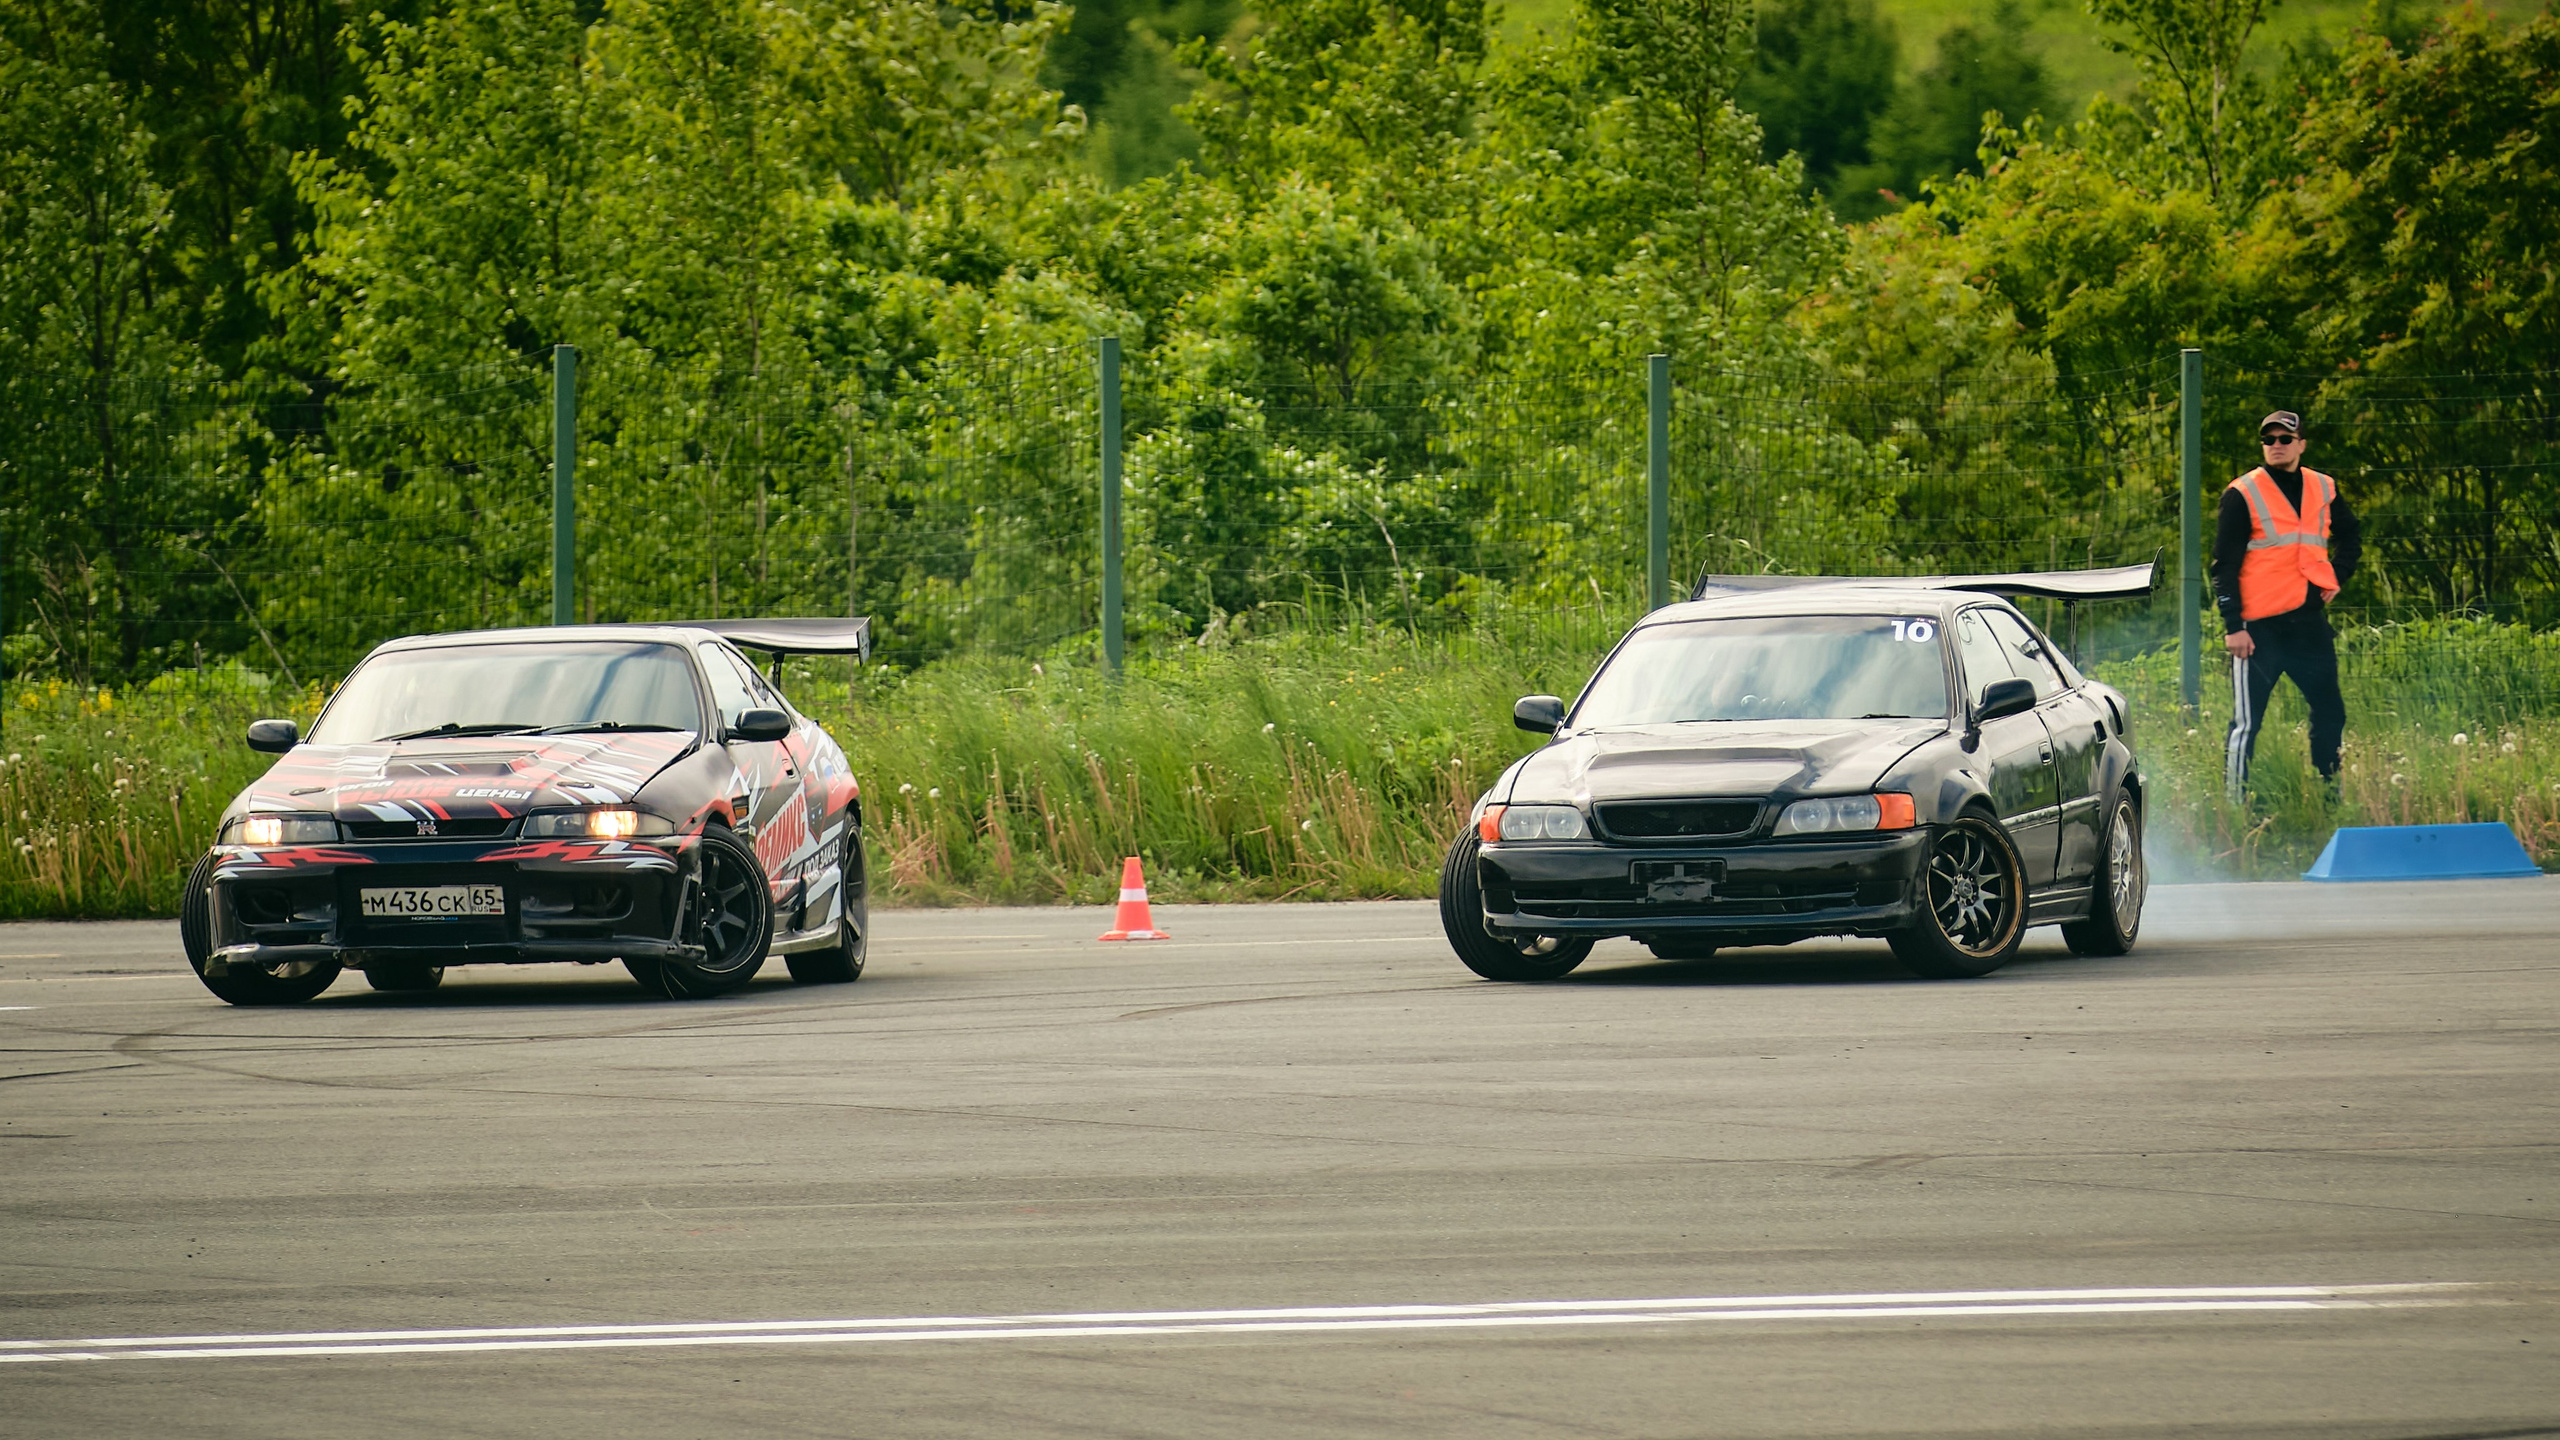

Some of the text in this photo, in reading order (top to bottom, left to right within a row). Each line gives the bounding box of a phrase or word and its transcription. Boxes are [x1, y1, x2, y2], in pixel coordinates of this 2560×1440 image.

[1891, 620, 1933, 643] 10
[456, 788, 532, 800] ЦЕНЫ
[472, 889, 496, 906] 65
